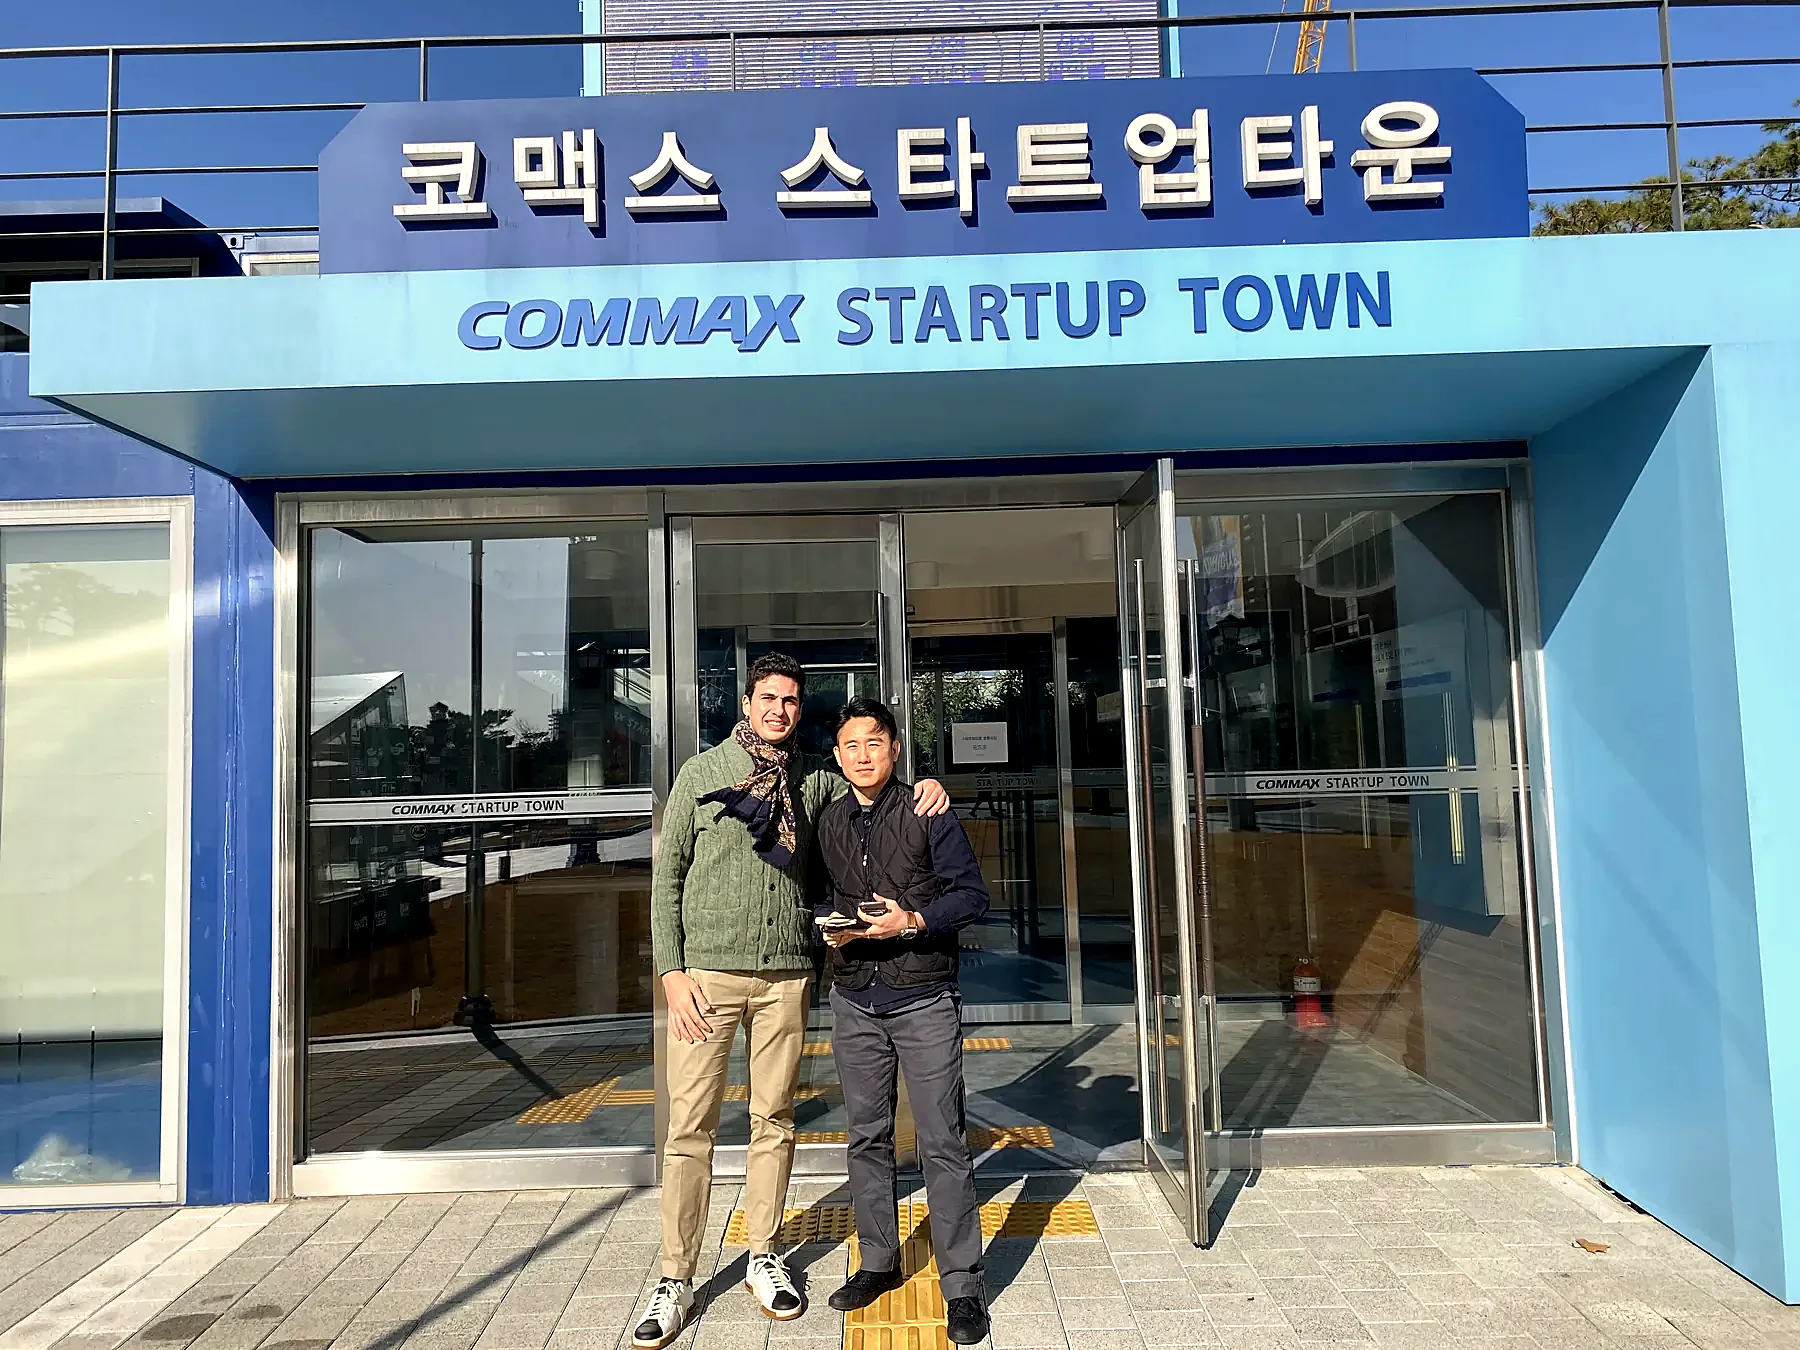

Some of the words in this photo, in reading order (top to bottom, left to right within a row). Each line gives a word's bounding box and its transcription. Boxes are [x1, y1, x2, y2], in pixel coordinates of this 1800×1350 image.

[393, 127, 722, 228] 코맥스
[776, 100, 1452, 219] 스타트업타운
[457, 293, 805, 352] COMMAX
[836, 279, 1146, 346] STARTUP
[1178, 271, 1392, 335] TOWN
[1256, 778, 1321, 790] COMMAX
[1326, 776, 1384, 789] STARTUP
[1390, 775, 1430, 788] TOWN
[391, 803, 456, 816] COMMAX
[460, 801, 519, 815] STARTUP
[524, 799, 566, 812] TOWN
